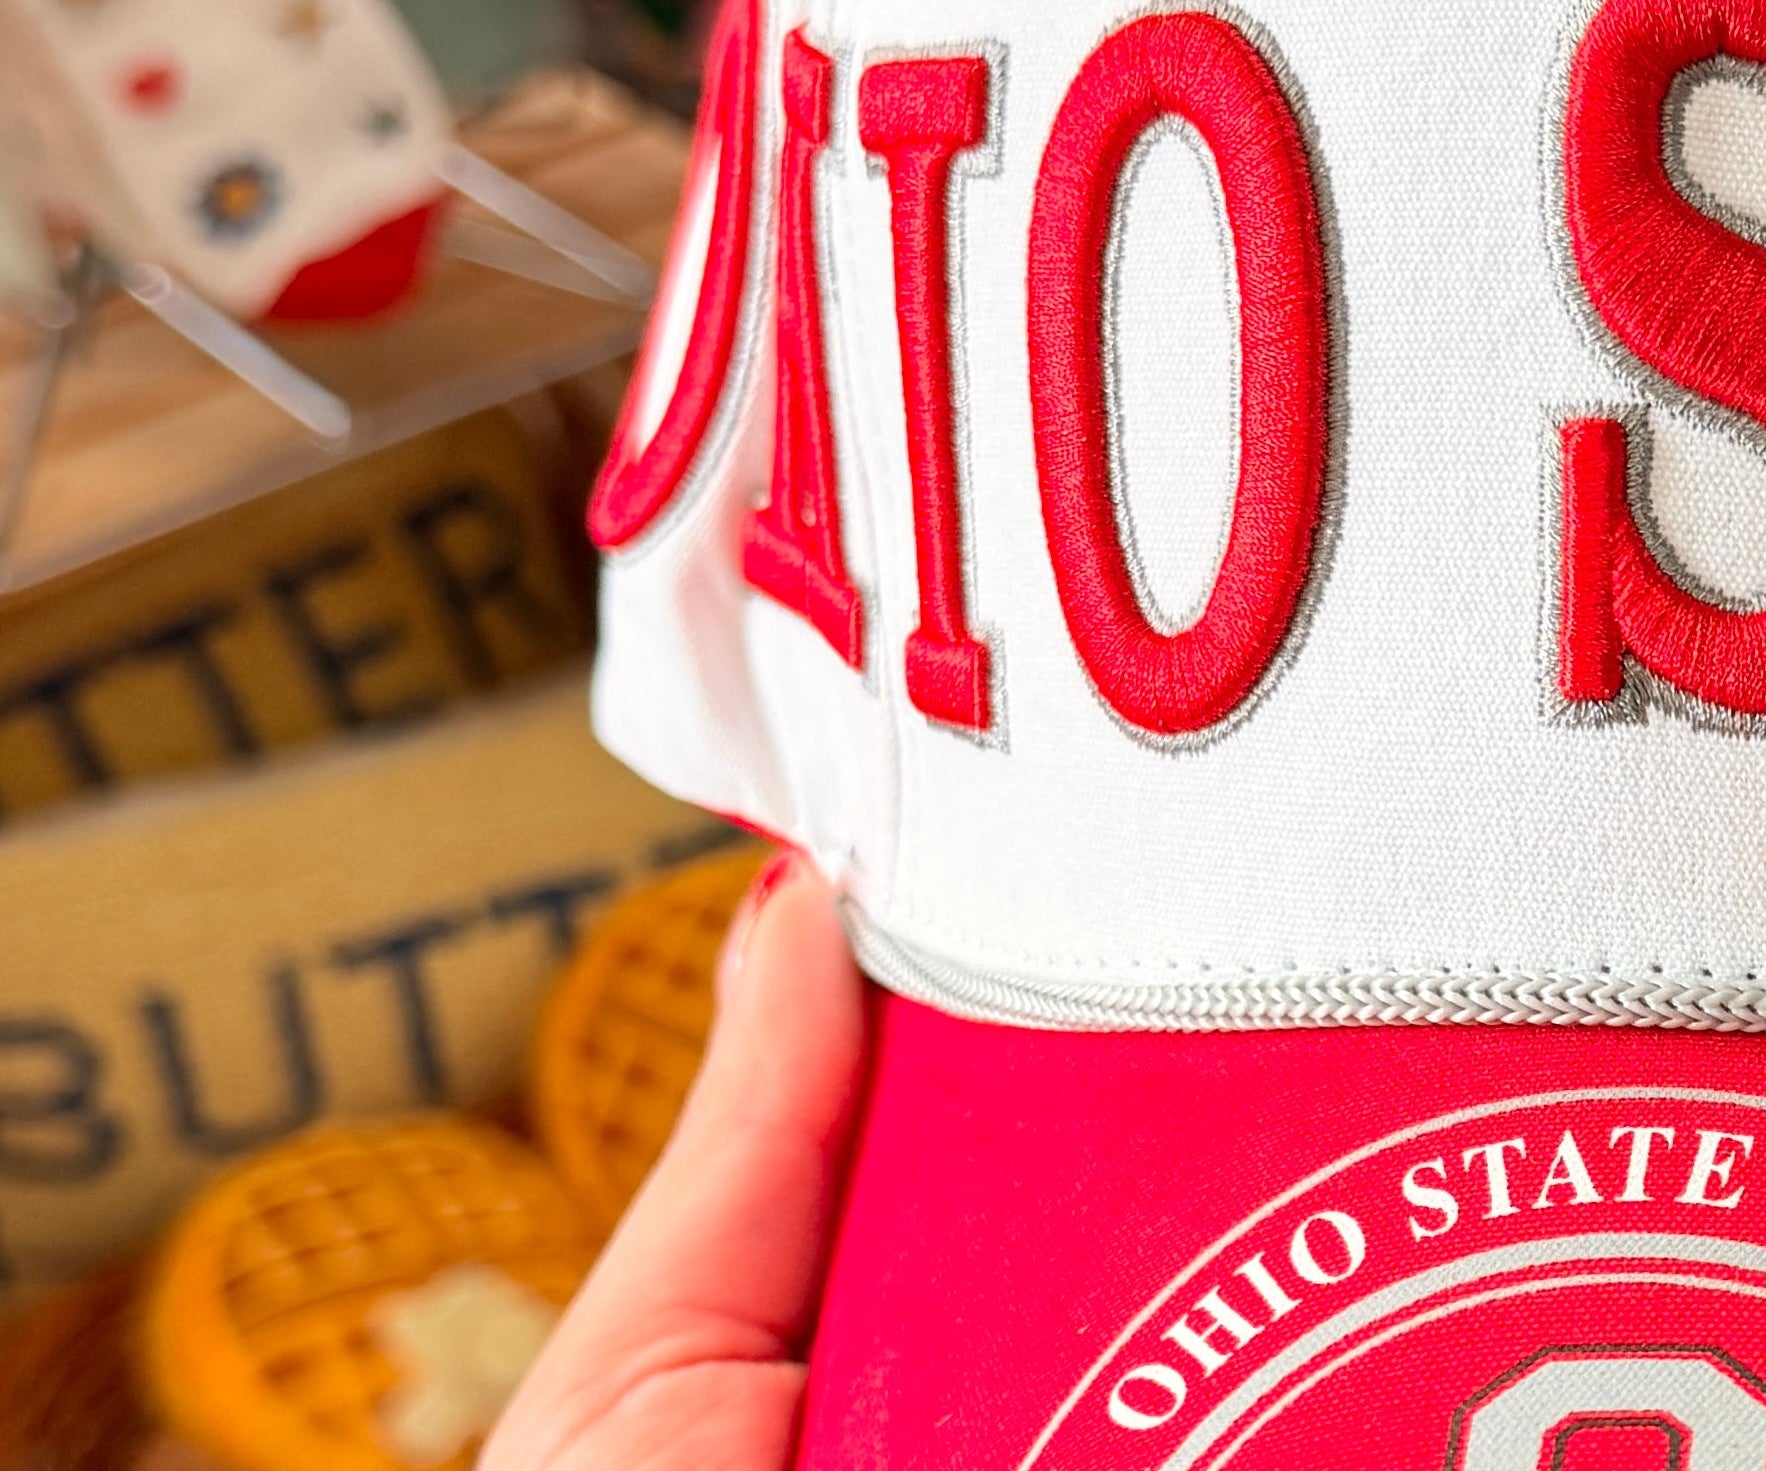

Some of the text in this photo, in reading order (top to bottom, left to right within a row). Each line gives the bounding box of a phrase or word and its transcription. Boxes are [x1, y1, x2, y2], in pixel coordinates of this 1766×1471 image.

[0, 824, 745, 1188] BUTT
[1107, 1210, 1367, 1431] OHIO
[1401, 1126, 1755, 1242] STATE
